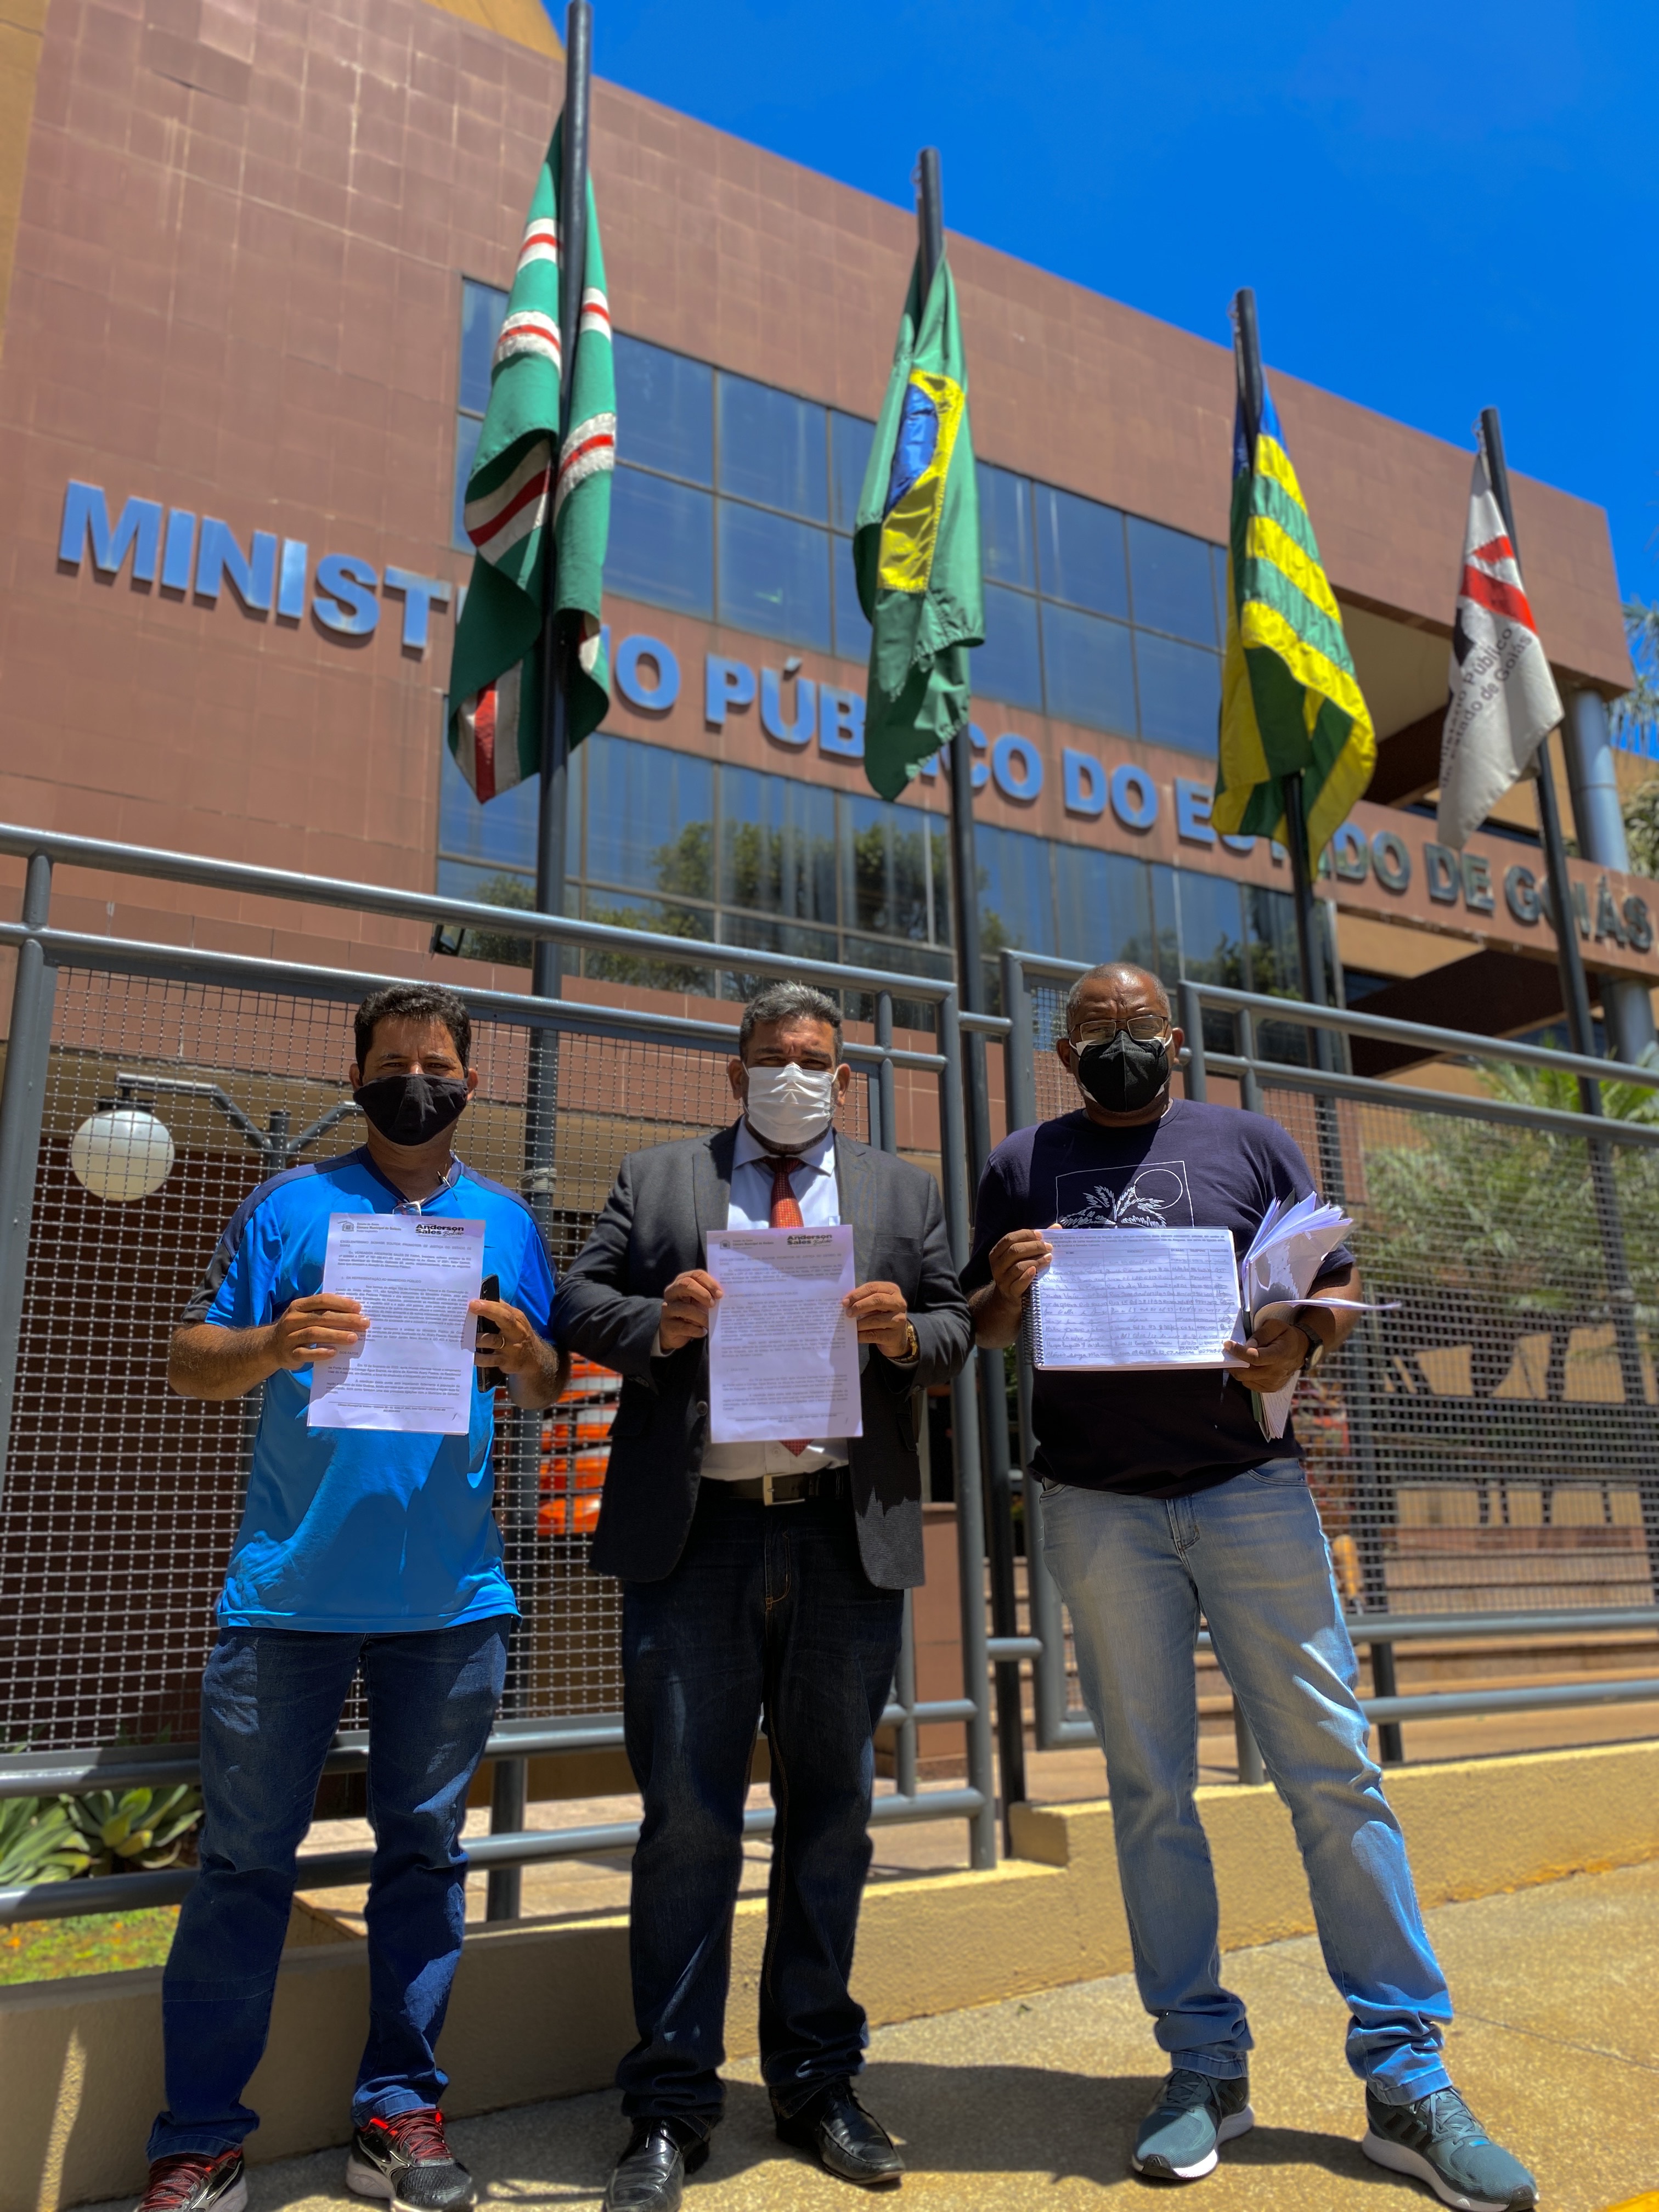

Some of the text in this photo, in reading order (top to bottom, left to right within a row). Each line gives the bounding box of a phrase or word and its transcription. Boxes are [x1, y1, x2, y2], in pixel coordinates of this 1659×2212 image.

[1463, 628, 1513, 685] Público
[1480, 682, 1499, 701] de
[1493, 635, 1532, 682] Goiás
[1062, 747, 1159, 829] DO
[1175, 777, 1411, 890] EDO
[1424, 843, 1496, 911] DE
